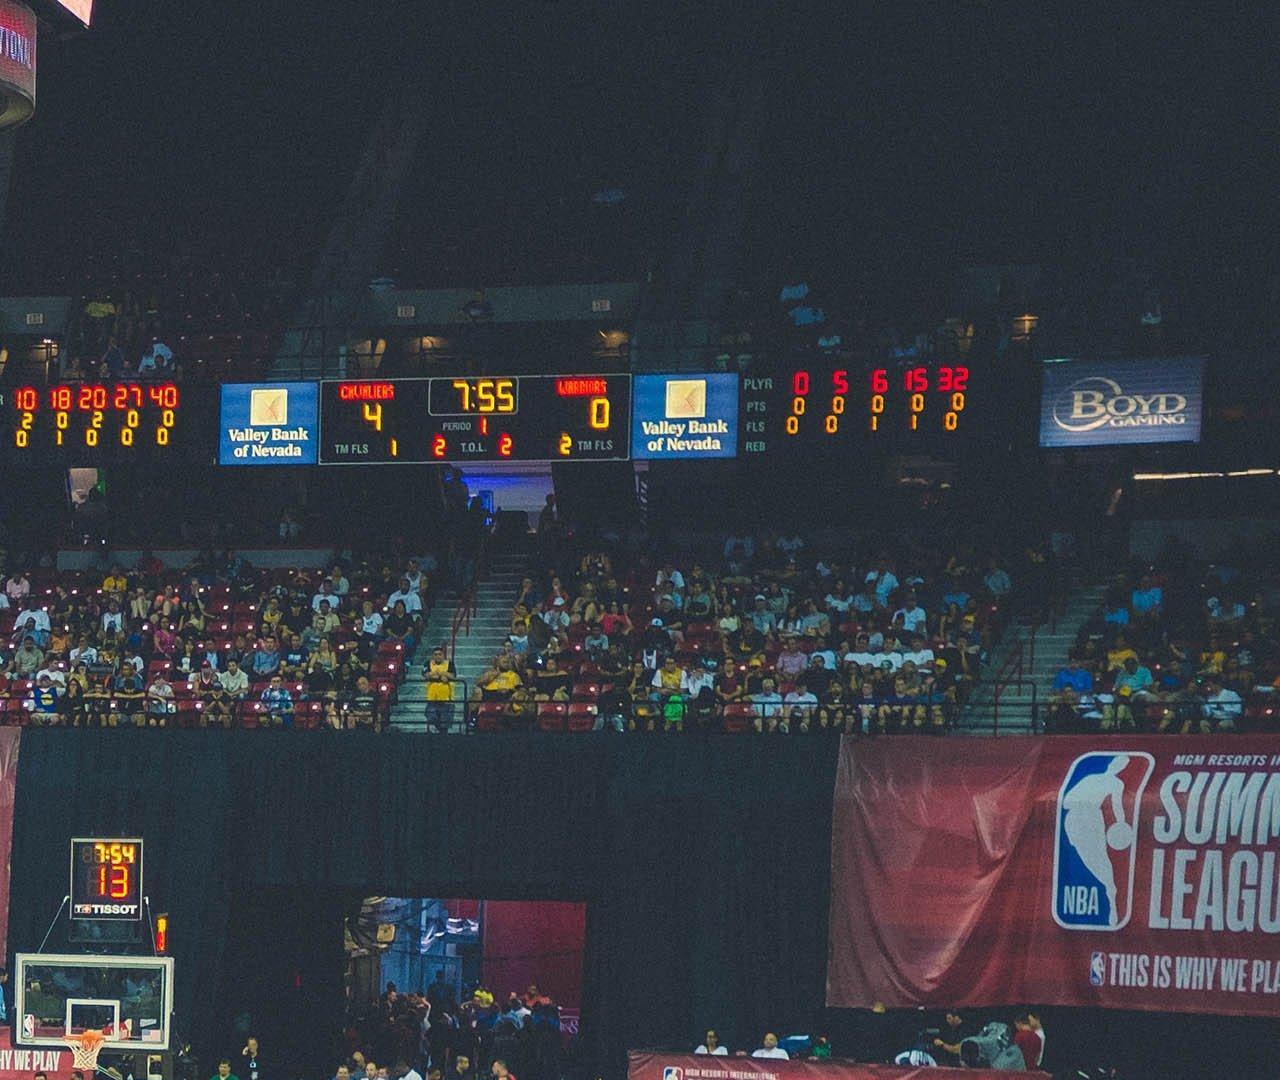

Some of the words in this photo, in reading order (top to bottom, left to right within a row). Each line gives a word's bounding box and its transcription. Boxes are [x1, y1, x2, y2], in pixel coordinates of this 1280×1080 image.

[743, 378, 773, 390] PLYR
[792, 371, 809, 395] 0
[832, 370, 849, 395] 5
[871, 369, 889, 394] 6
[904, 367, 929, 392] 15
[936, 366, 970, 393] 32
[16, 389, 37, 411] 10
[51, 388, 71, 410] 18
[79, 388, 107, 410] 20
[115, 387, 142, 409] 27
[150, 386, 177, 409] 40
[452, 379, 515, 412] 7:55
[746, 401, 766, 412] PTS
[793, 396, 806, 416] 0
[832, 395, 845, 415] 0
[871, 394, 885, 414] 0
[911, 393, 924, 413] 0
[951, 391, 965, 412] 0
[1071, 390, 1188, 420] BOYD
[21, 412, 33, 430] 2
[57, 411, 68, 430] 0
[92, 411, 103, 430] 2
[127, 410, 139, 429] 0
[163, 410, 175, 428] 0
[363, 402, 383, 432] 4
[591, 397, 611, 430] 0
[746, 420, 765, 432] FLS
[785, 415, 799, 435] 0
[944, 411, 958, 431] 0
[1109, 413, 1186, 428] GAMING
[15, 429, 28, 448] 0
[56, 430, 63, 446] 1
[86, 428, 98, 447] 0
[120, 427, 133, 446] 0
[156, 427, 169, 446] 0
[229, 427, 267, 445] Valley
[271, 426, 309, 441] Bank
[481, 418, 488, 436] 1
[641, 420, 686, 438] Valley
[688, 419, 729, 435] Bank
[233, 443, 249, 457] of
[251, 443, 303, 458] Nevada
[334, 444, 349, 454] TM
[351, 444, 369, 455] FLS
[390, 437, 398, 457] 1
[433, 437, 445, 456] 2
[501, 437, 513, 456] 2
[559, 433, 573, 456] 2
[578, 441, 592, 451] TM
[594, 440, 614, 451] FLS
[647, 437, 664, 452] of
[666, 436, 722, 451] Nevada
[745, 441, 766, 452] REB
[1173, 754, 1204, 766] MGM
[1207, 754, 1268, 766] RESORTS
[94, 843, 136, 865] 7:54
[99, 865, 129, 898] 13
[93, 904, 138, 915] TISSOT
[1063, 885, 1100, 916] NBA
[1109, 953, 1150, 987] THIS
[1153, 955, 1172, 988] IS
[1175, 955, 1218, 991] WHY
[1220, 957, 1249, 993] WE
[13, 1050, 32, 1071] WE
[32, 1050, 61, 1071] PLAY
